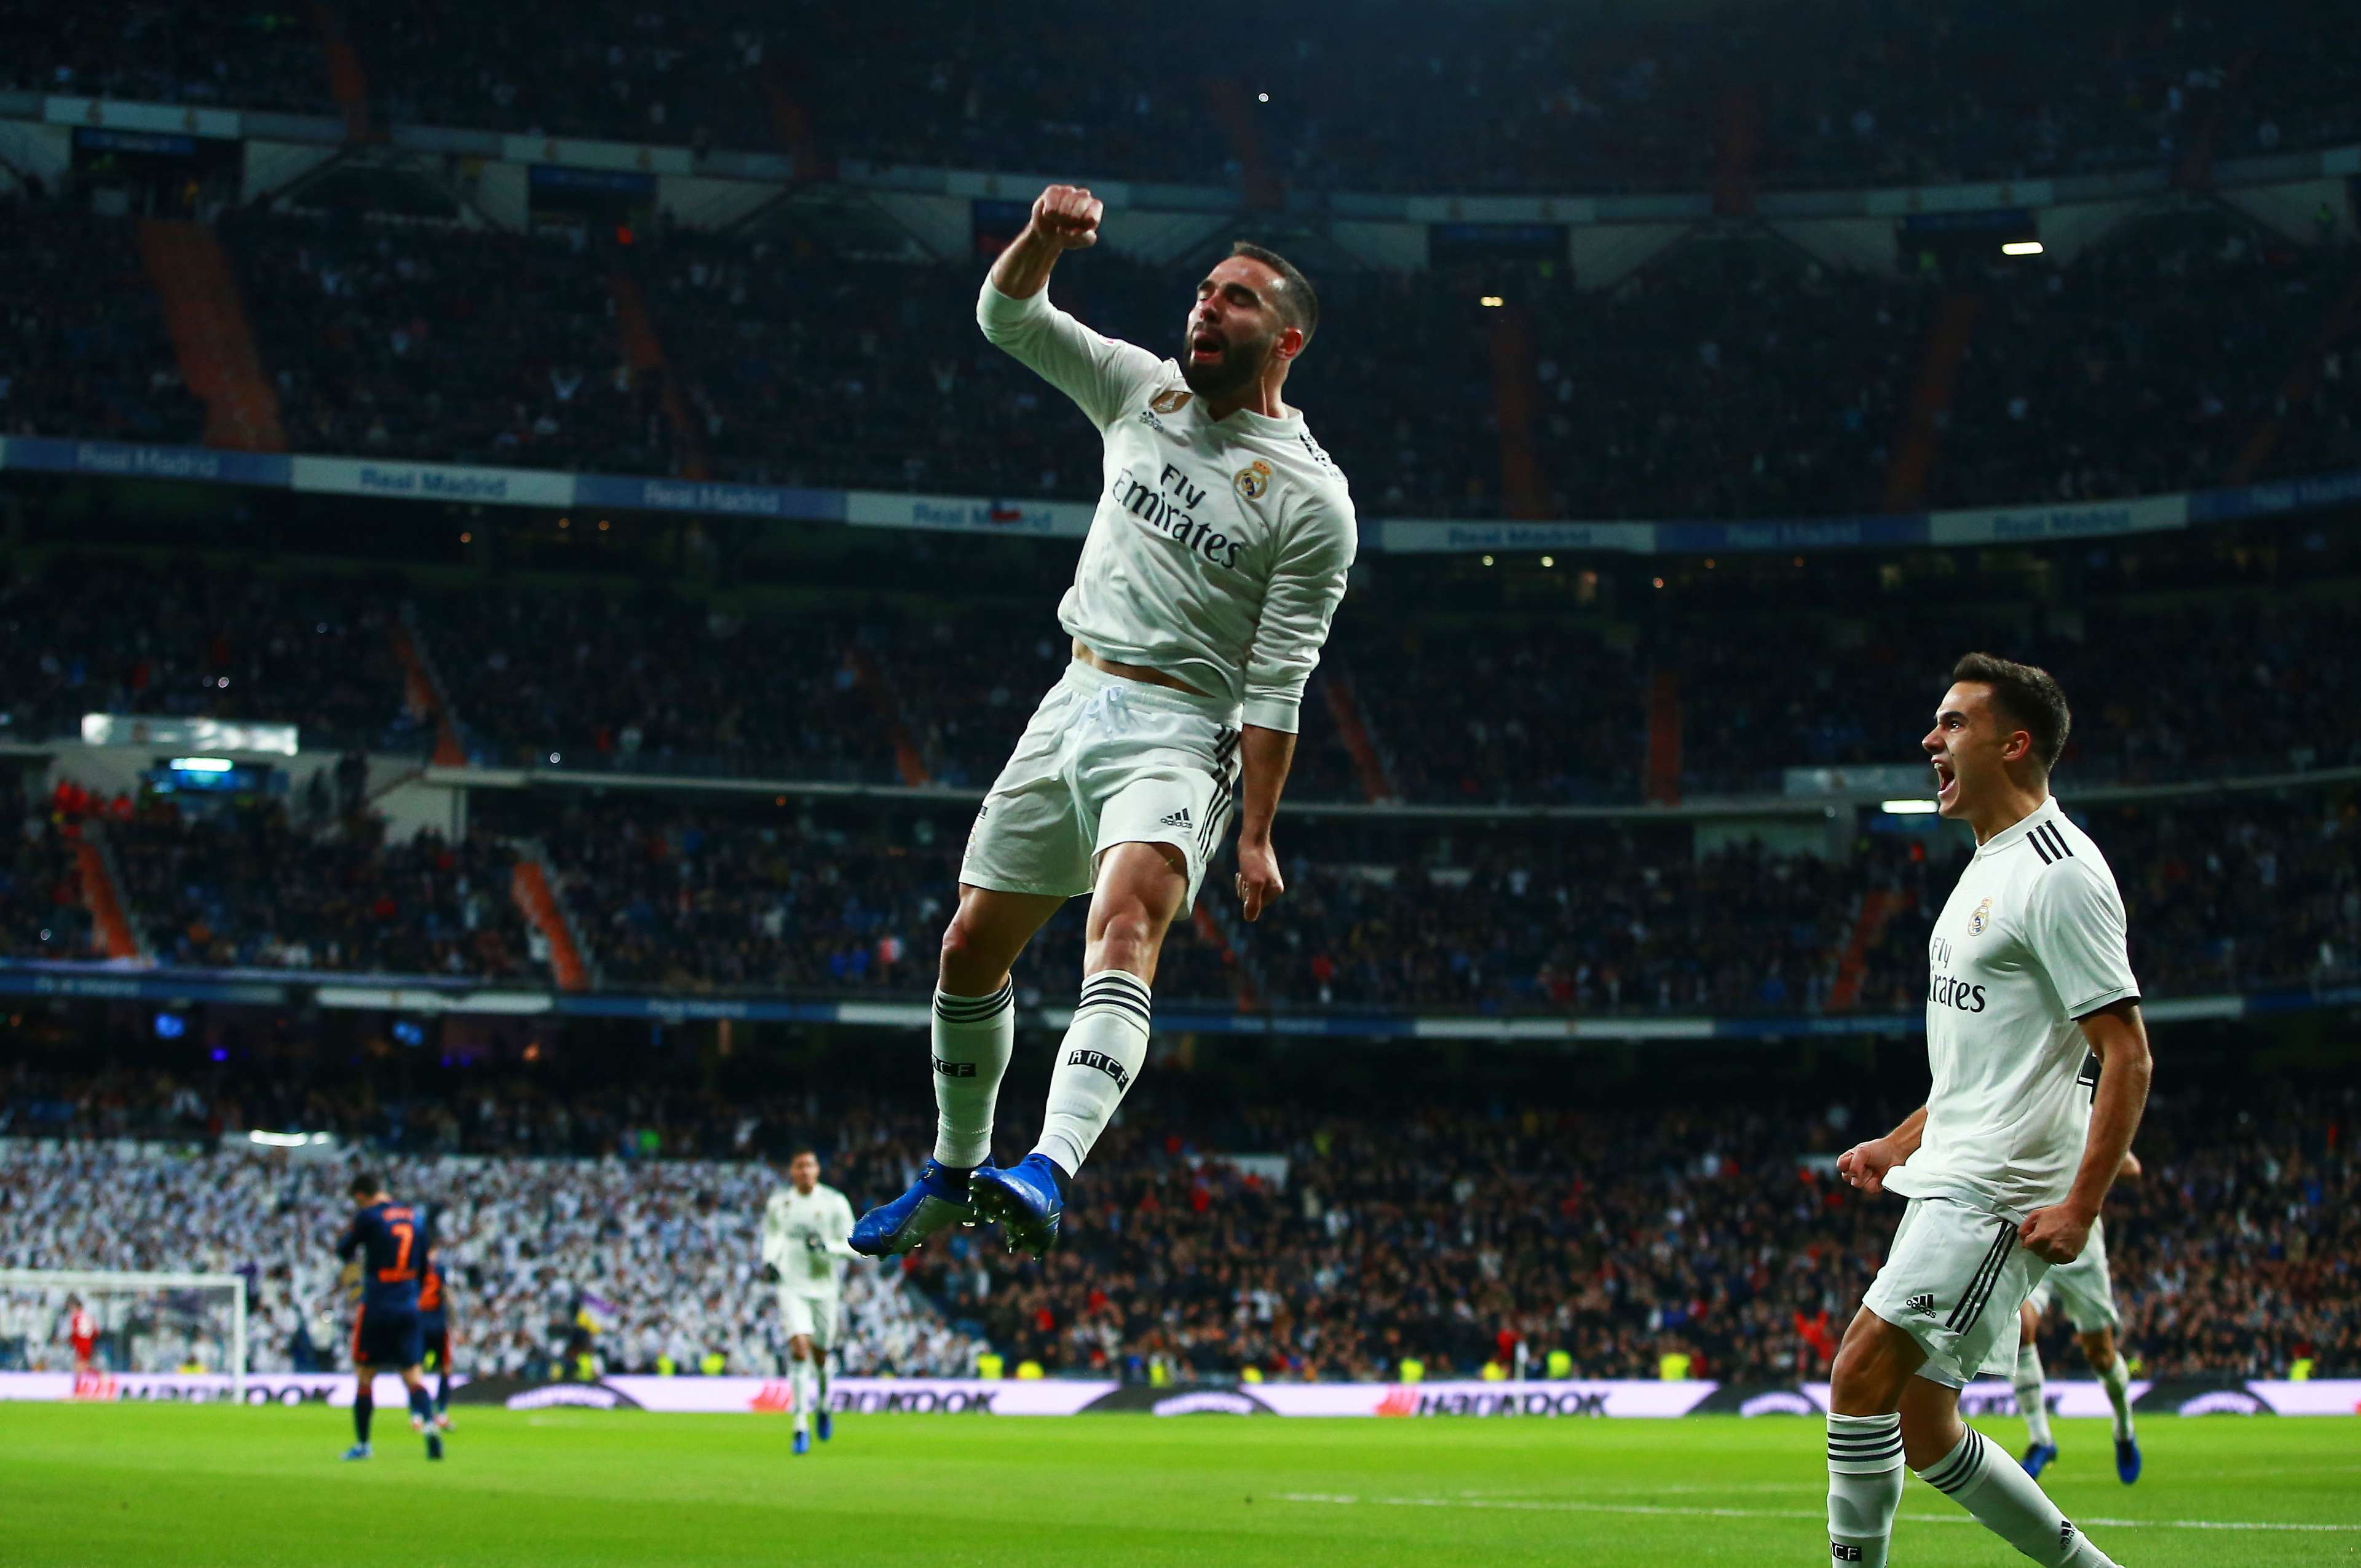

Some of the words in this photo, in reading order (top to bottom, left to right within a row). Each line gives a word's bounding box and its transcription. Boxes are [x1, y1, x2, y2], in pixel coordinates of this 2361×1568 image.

[360, 467, 416, 490] Real
[422, 473, 508, 498] Madrid
[1160, 463, 1206, 510] Fly
[912, 504, 964, 524] Real
[1113, 467, 1242, 569] Emirates
[1160, 818, 1193, 829] adidas
[1931, 937, 1952, 969] Fly
[1070, 1049, 1128, 1085] RMCF
[1906, 1299, 1937, 1319] adidas
